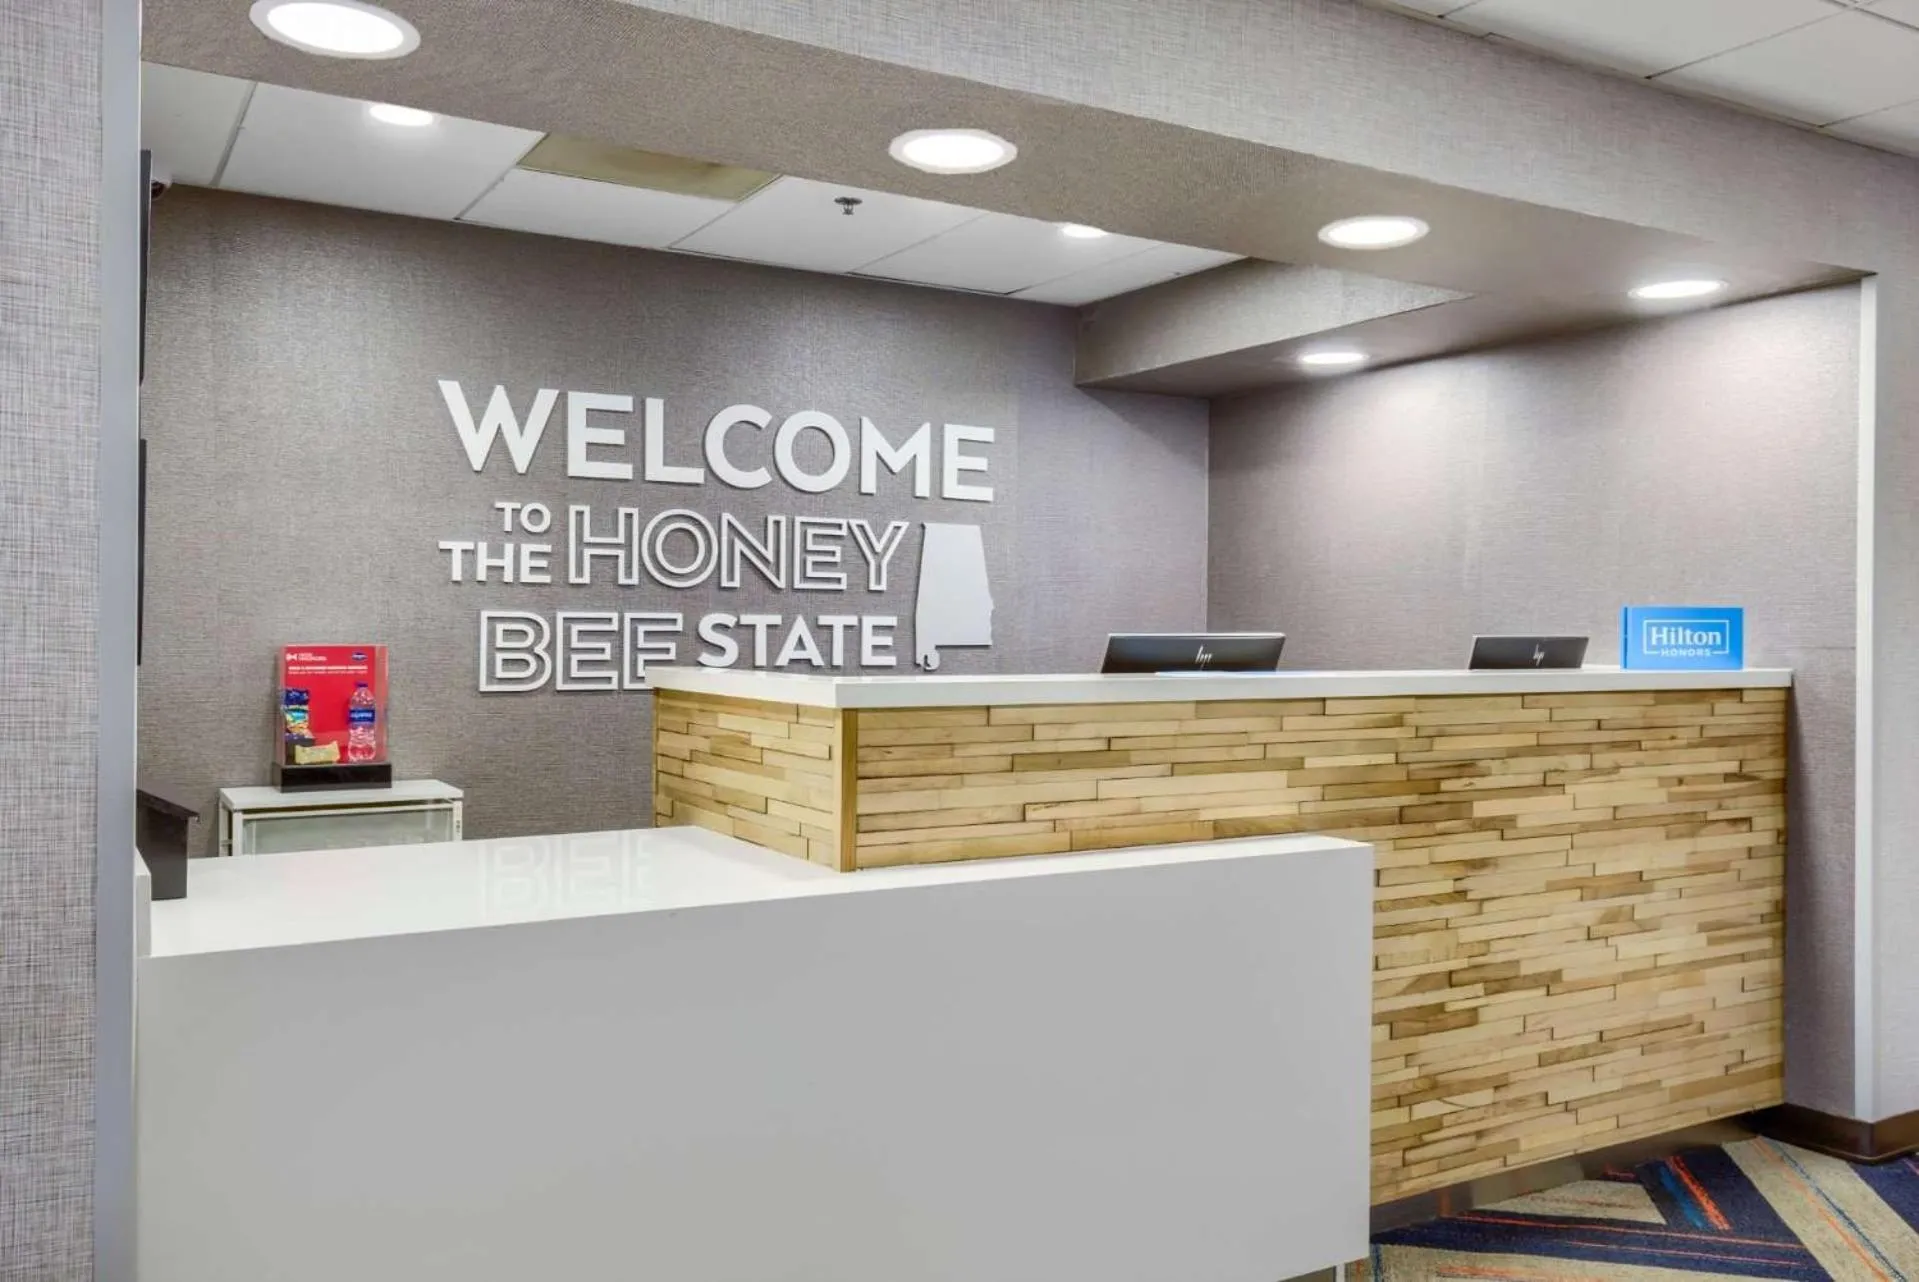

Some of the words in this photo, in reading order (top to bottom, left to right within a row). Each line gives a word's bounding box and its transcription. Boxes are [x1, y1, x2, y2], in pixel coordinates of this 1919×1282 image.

[438, 379, 995, 501] WELCOME
[495, 501, 551, 534] TO
[438, 540, 552, 584] THE
[568, 504, 909, 592] HONEY
[479, 610, 683, 692] BEE
[697, 612, 898, 669] STATE
[1651, 626, 1722, 645] Hilton
[1660, 648, 1712, 657] HONORS
